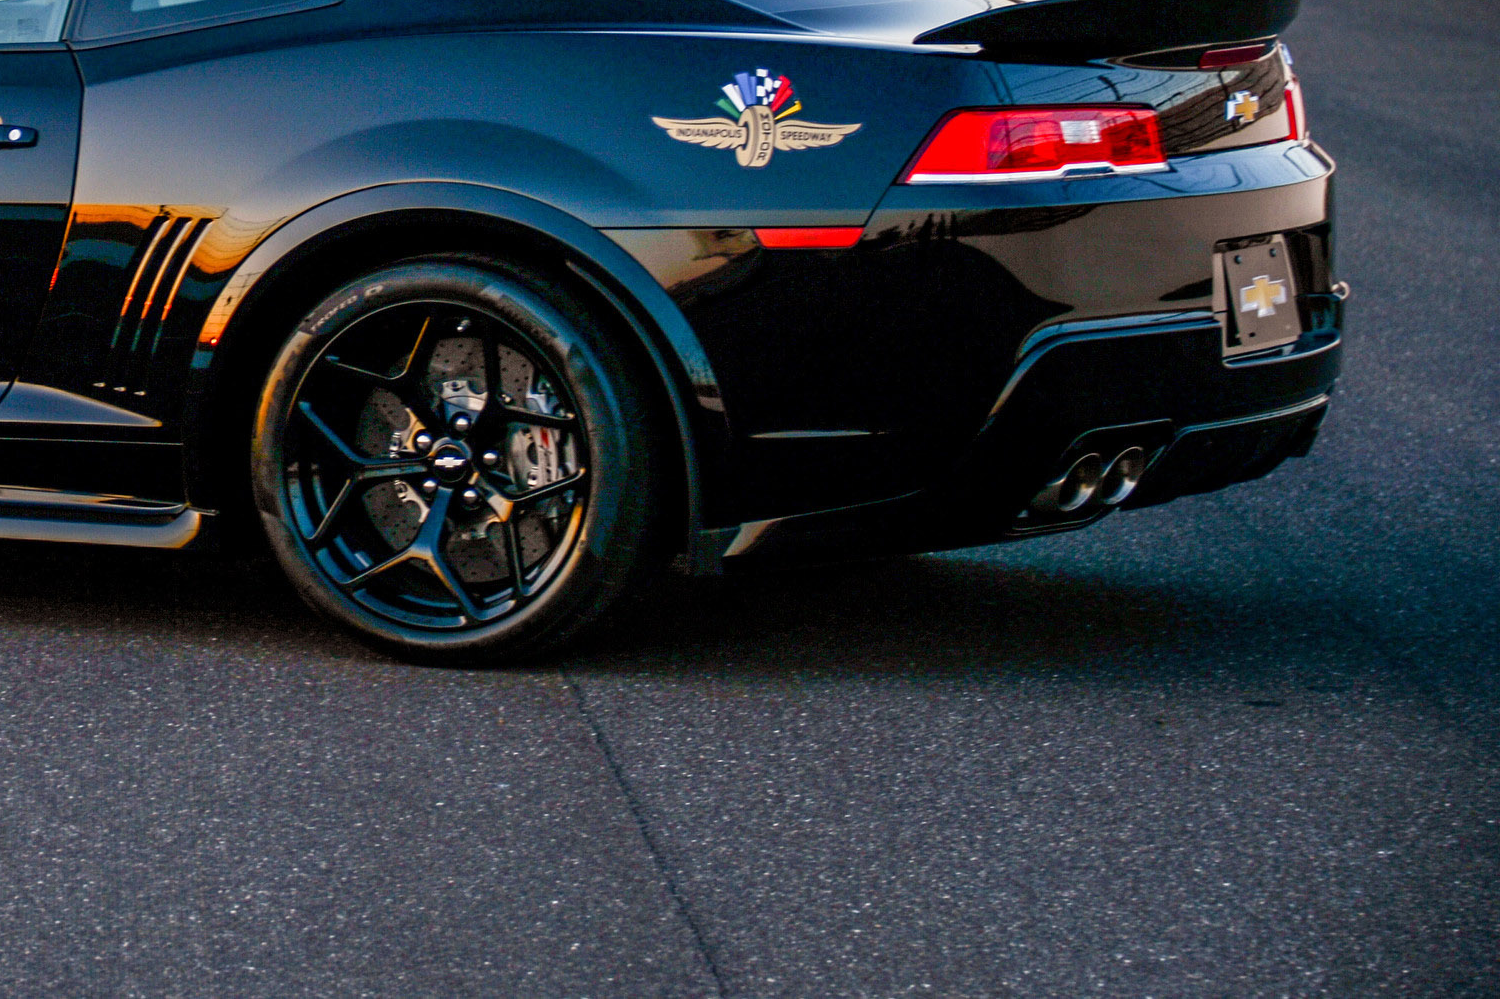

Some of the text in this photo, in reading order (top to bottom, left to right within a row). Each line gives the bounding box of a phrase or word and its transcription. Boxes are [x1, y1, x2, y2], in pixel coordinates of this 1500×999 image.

[676, 128, 743, 139] INDIANAPOLIS
[756, 113, 771, 161] MOTOR
[780, 130, 832, 142] SPEEDWAY
